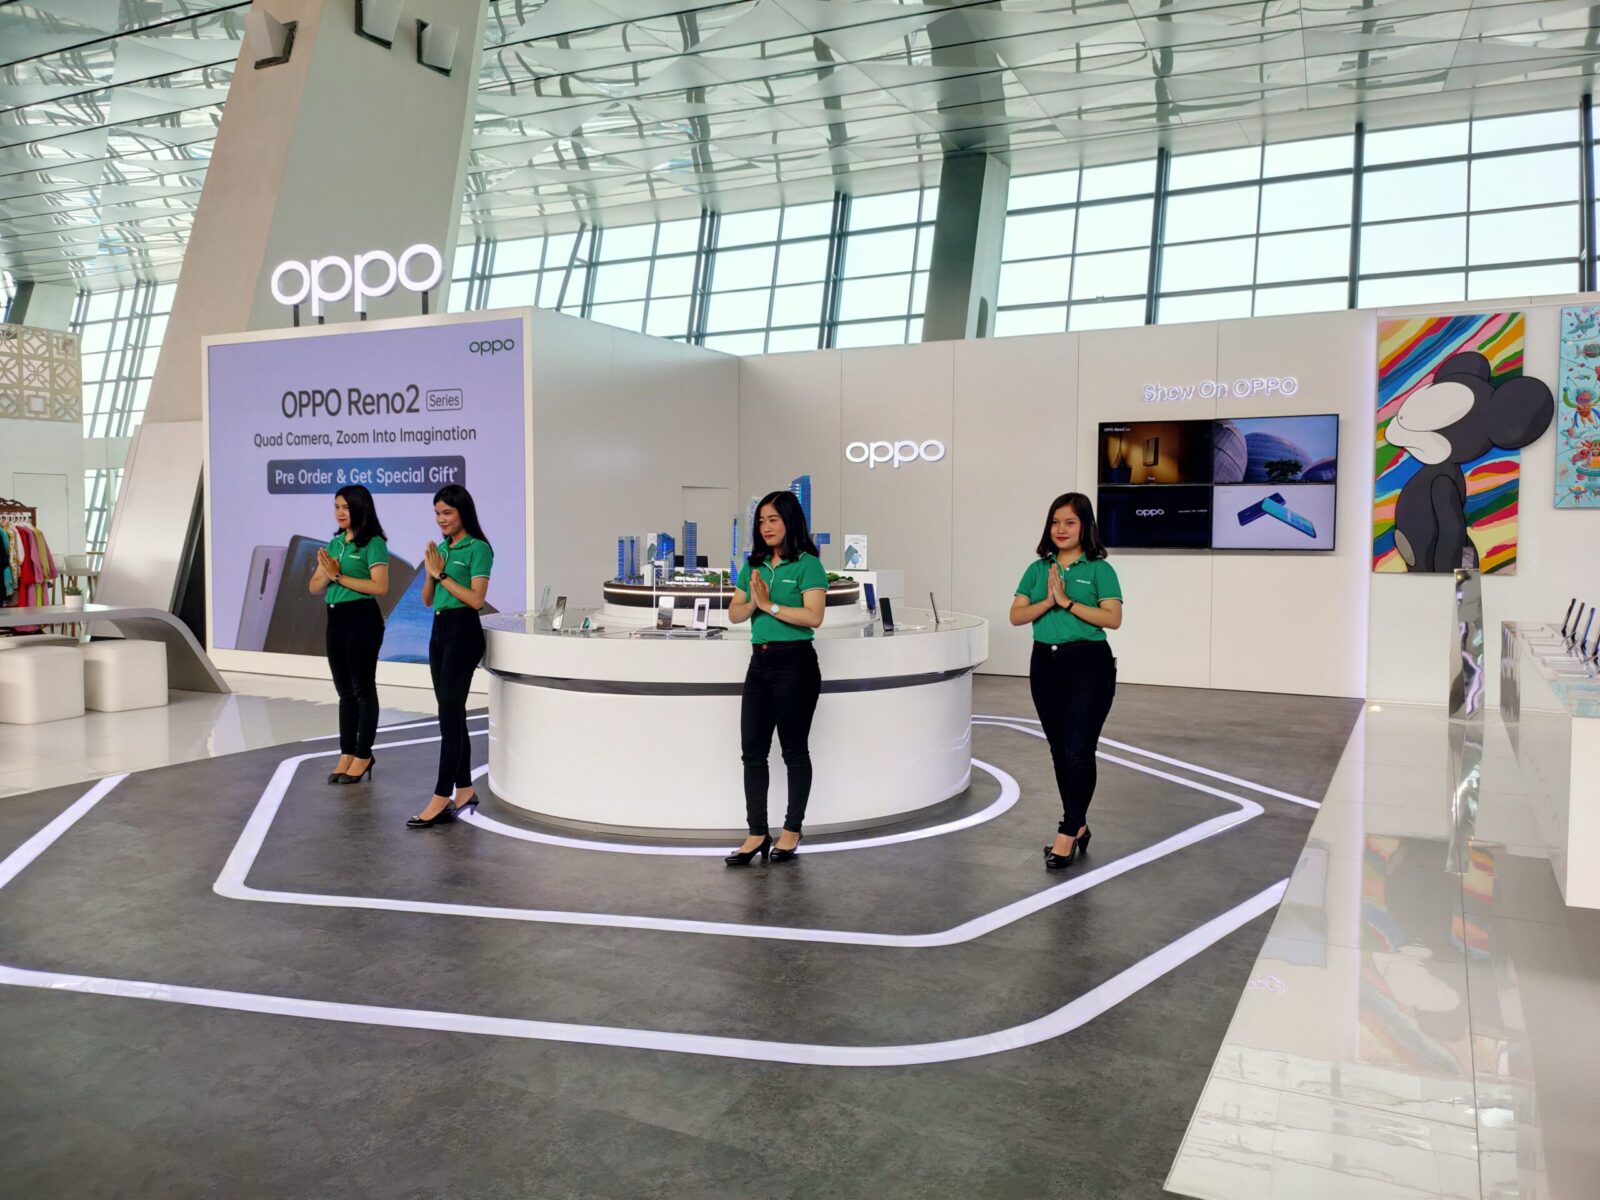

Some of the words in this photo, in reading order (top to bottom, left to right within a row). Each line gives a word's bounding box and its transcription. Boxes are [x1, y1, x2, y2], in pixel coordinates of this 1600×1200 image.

[271, 243, 443, 317] oppo
[469, 338, 515, 356] oppo
[281, 388, 342, 418] OPPO
[347, 384, 420, 416] Reno2
[429, 394, 460, 407] Series
[1143, 384, 1194, 402] Show
[1199, 380, 1227, 399] On
[1233, 376, 1298, 397] OPPO
[254, 432, 283, 448] Quad
[286, 431, 333, 447] Camera,
[336, 430, 370, 445] Zoom
[372, 428, 397, 443] Into
[400, 425, 477, 445] Imagination
[845, 439, 946, 469] oppo
[275, 469, 295, 485] Pre
[298, 468, 333, 484] Order
[336, 468, 346, 484] &
[349, 467, 373, 484] Get
[376, 466, 425, 487] Special
[1135, 508, 1165, 517] oppo
